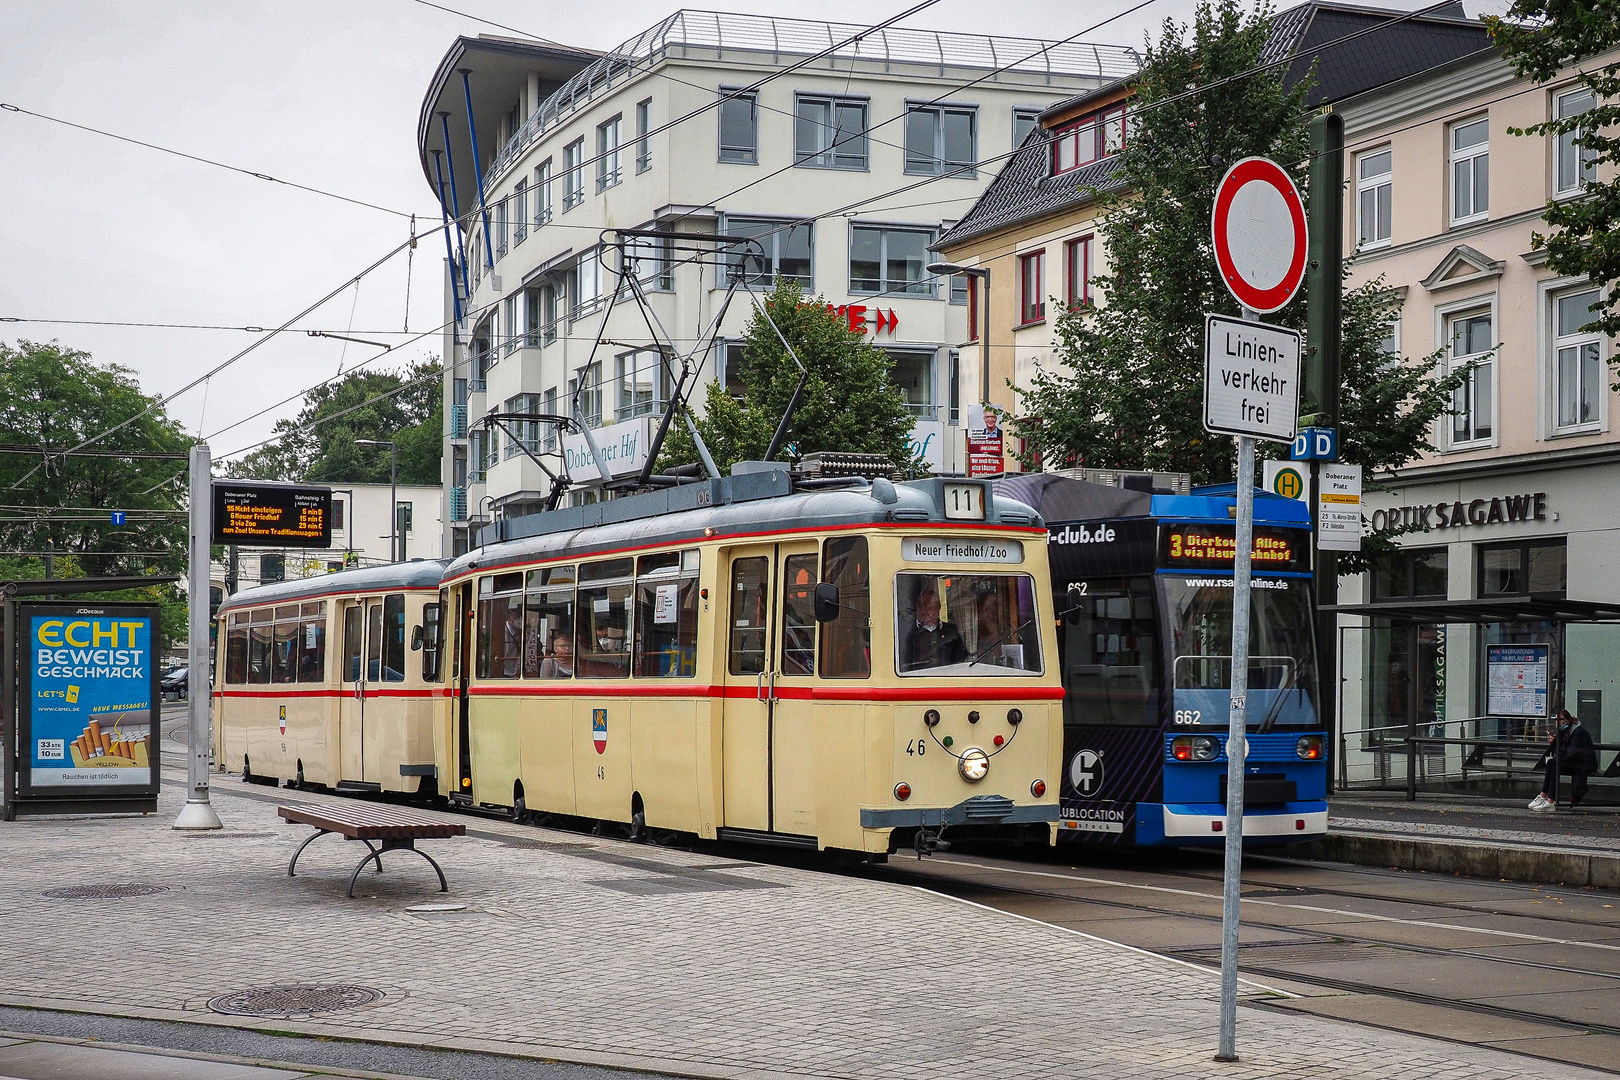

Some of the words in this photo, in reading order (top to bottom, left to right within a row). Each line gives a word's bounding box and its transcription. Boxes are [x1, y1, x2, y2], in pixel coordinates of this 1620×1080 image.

[1226, 332, 1285, 364] Linien-
[1221, 368, 1287, 396] verkehr
[1241, 398, 1270, 424] frei
[566, 445, 617, 470] Dobener
[620, 430, 639, 464] Hof
[1295, 435, 1307, 456] D
[1316, 434, 1331, 455] D
[1325, 473, 1356, 481] Doberaner
[951, 488, 971, 511] 11
[235, 505, 250, 513] Nicht
[114, 513, 123, 524] T
[254, 513, 280, 521] Friedhof
[270, 528, 319, 537] Traditionswagen
[915, 543, 942, 557] Neuer
[946, 544, 1007, 558] Friedhof/Zoo
[1170, 534, 1182, 557] 3
[1255, 538, 1286, 549] Allee
[1184, 547, 1204, 557] via
[1206, 547, 1291, 560] Haupahnhof
[1185, 578, 1288, 590] www.rsanline.de
[38, 620, 144, 648] ECHT
[38, 649, 144, 666] BEWEIST
[37, 666, 143, 678] GESCHMACK
[38, 690, 65, 698] LET'S
[112, 702, 148, 710] MESSAGES!
[1175, 710, 1201, 725] 662
[906, 739, 926, 756] 46
[597, 766, 605, 780] 46
[1064, 821, 1111, 830] Rstock
